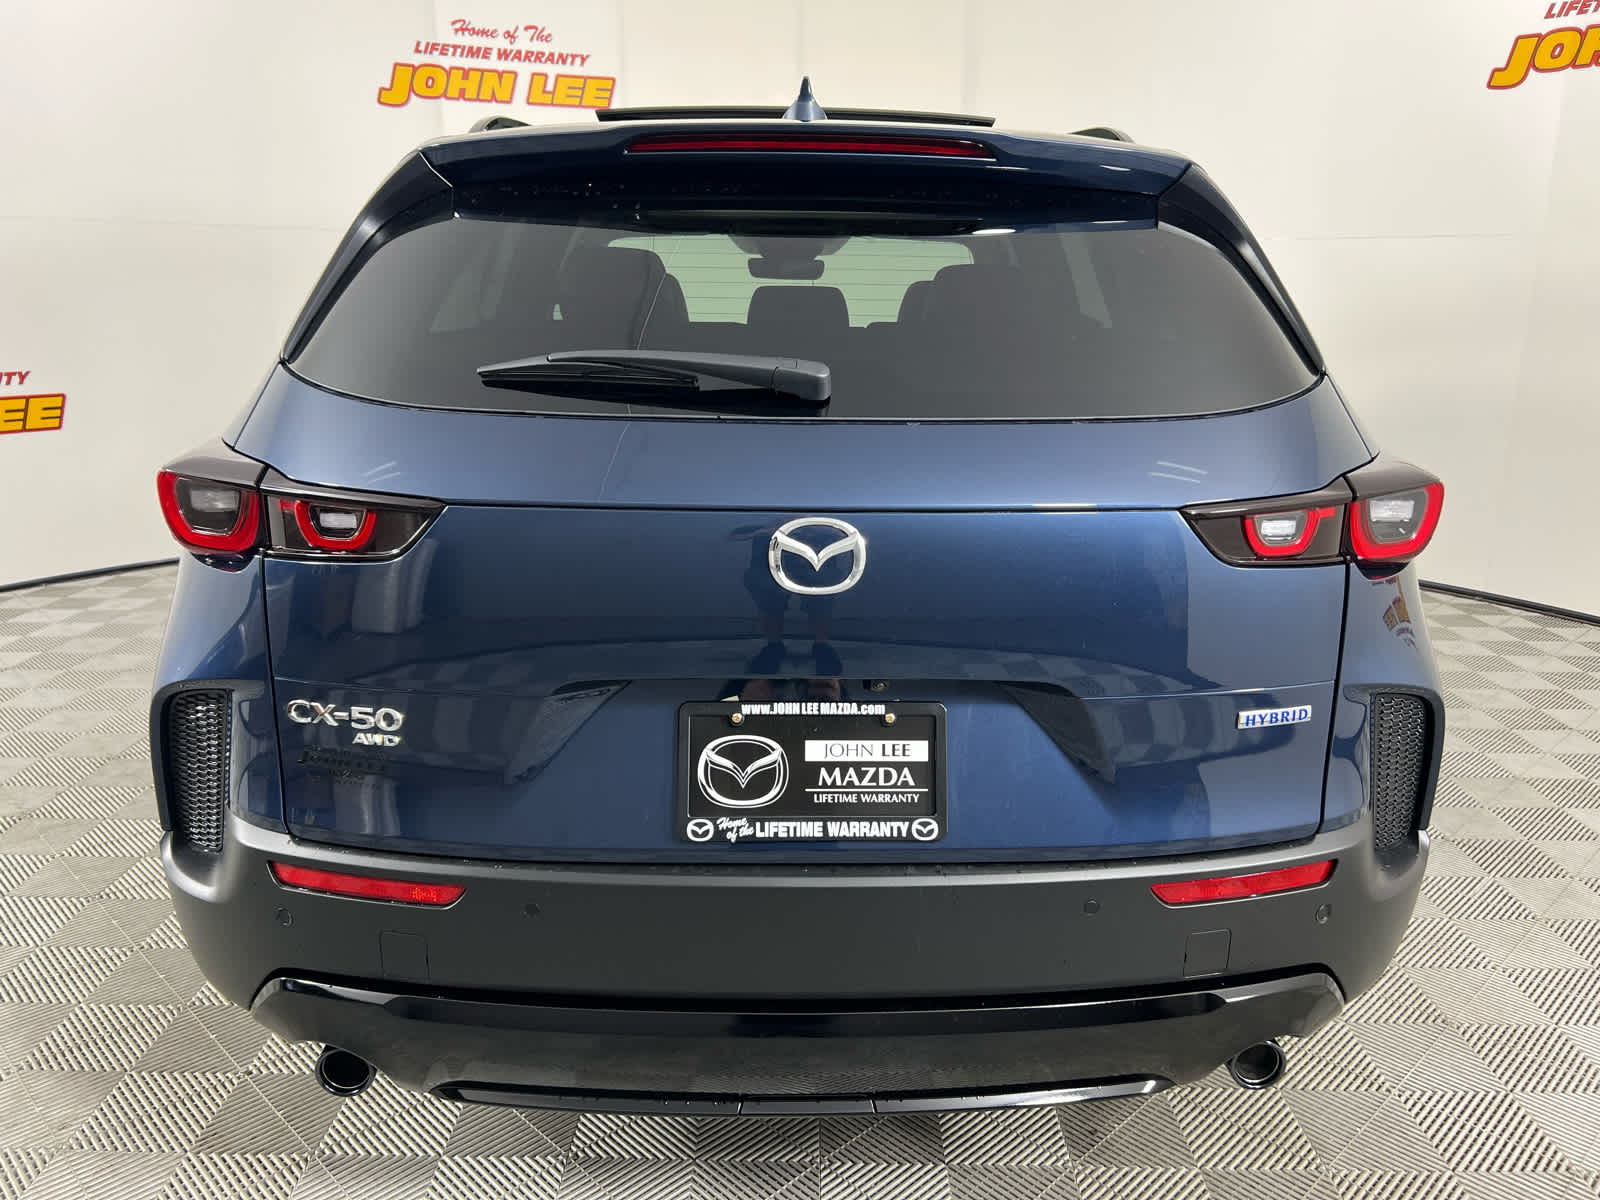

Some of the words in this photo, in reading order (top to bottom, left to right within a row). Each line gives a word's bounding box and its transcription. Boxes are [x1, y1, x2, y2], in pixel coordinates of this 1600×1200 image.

[450, 19, 498, 40] Home
[503, 28, 518, 45] of
[523, 25, 554, 43] The
[414, 41, 493, 60] LIFETIME
[496, 47, 591, 67] WARRANTY
[377, 62, 518, 108] JOHN
[526, 72, 616, 109] LEE
[287, 699, 404, 731] CX-50
[741, 702, 800, 715] www.JOHN
[801, 702, 819, 715] LEE
[820, 702, 885, 715] MAZDA.com
[1245, 708, 1309, 727] HYBRID
[352, 732, 401, 747] AWD
[824, 743, 874, 759] JOHN
[881, 743, 911, 757] LEE
[818, 766, 916, 786] MAZDA
[813, 793, 858, 804] LIFETIME
[860, 793, 920, 804] WARRANTY
[716, 816, 748, 831] Home
[755, 821, 823, 838] LIFETIME
[827, 821, 910, 838] WARRANTY
[726, 827, 738, 844] of
[738, 823, 755, 837] the
